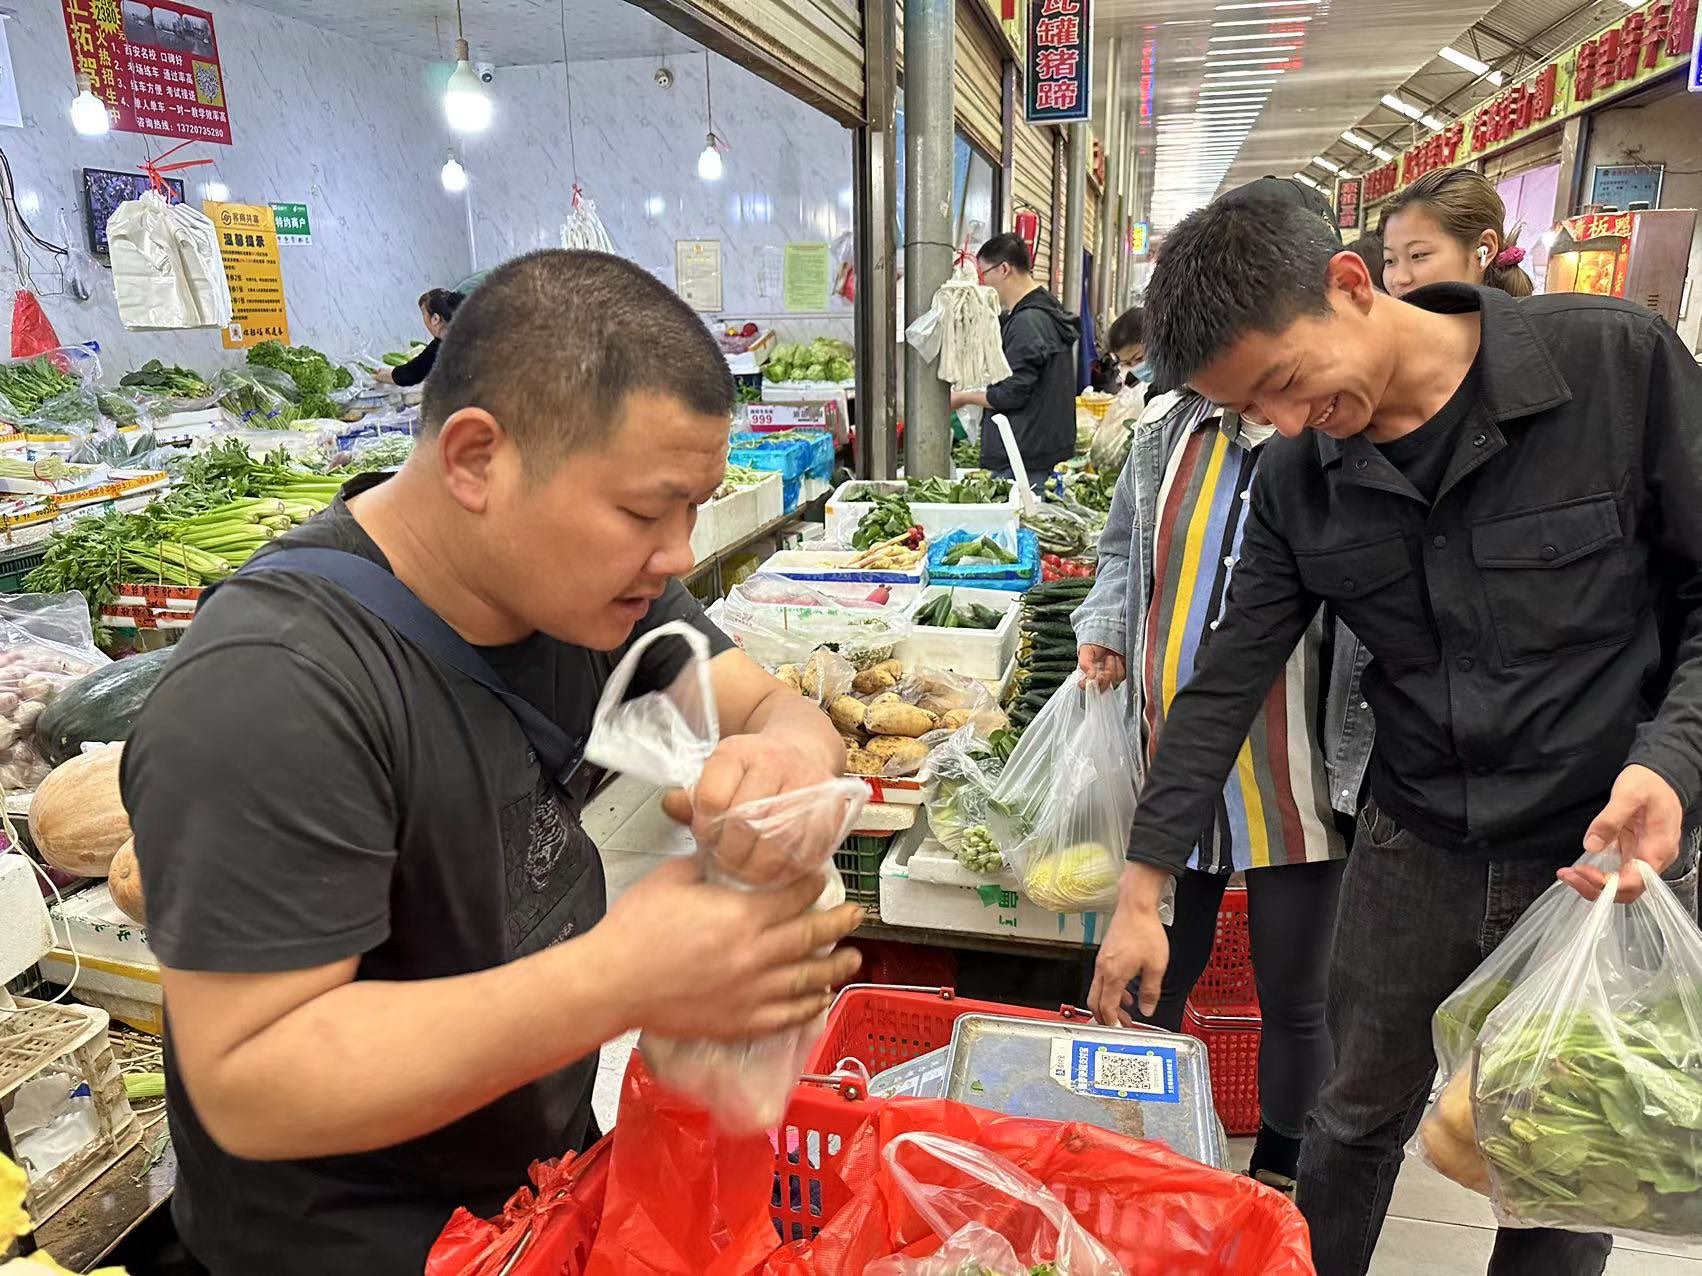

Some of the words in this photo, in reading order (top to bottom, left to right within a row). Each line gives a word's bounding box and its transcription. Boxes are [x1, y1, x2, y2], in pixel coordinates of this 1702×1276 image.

[95, 5, 117, 25] 2380
[160, 52, 183, 67] 口碑好
[96, 28, 121, 124] 火热招生中
[163, 69, 194, 85] 通过率高
[166, 86, 197, 102] 考试接送
[169, 104, 227, 123] 一对一教学效率高
[275, 215, 306, 229] 特约商户
[223, 232, 265, 248] 温馨提示
[752, 414, 773, 424] 999
